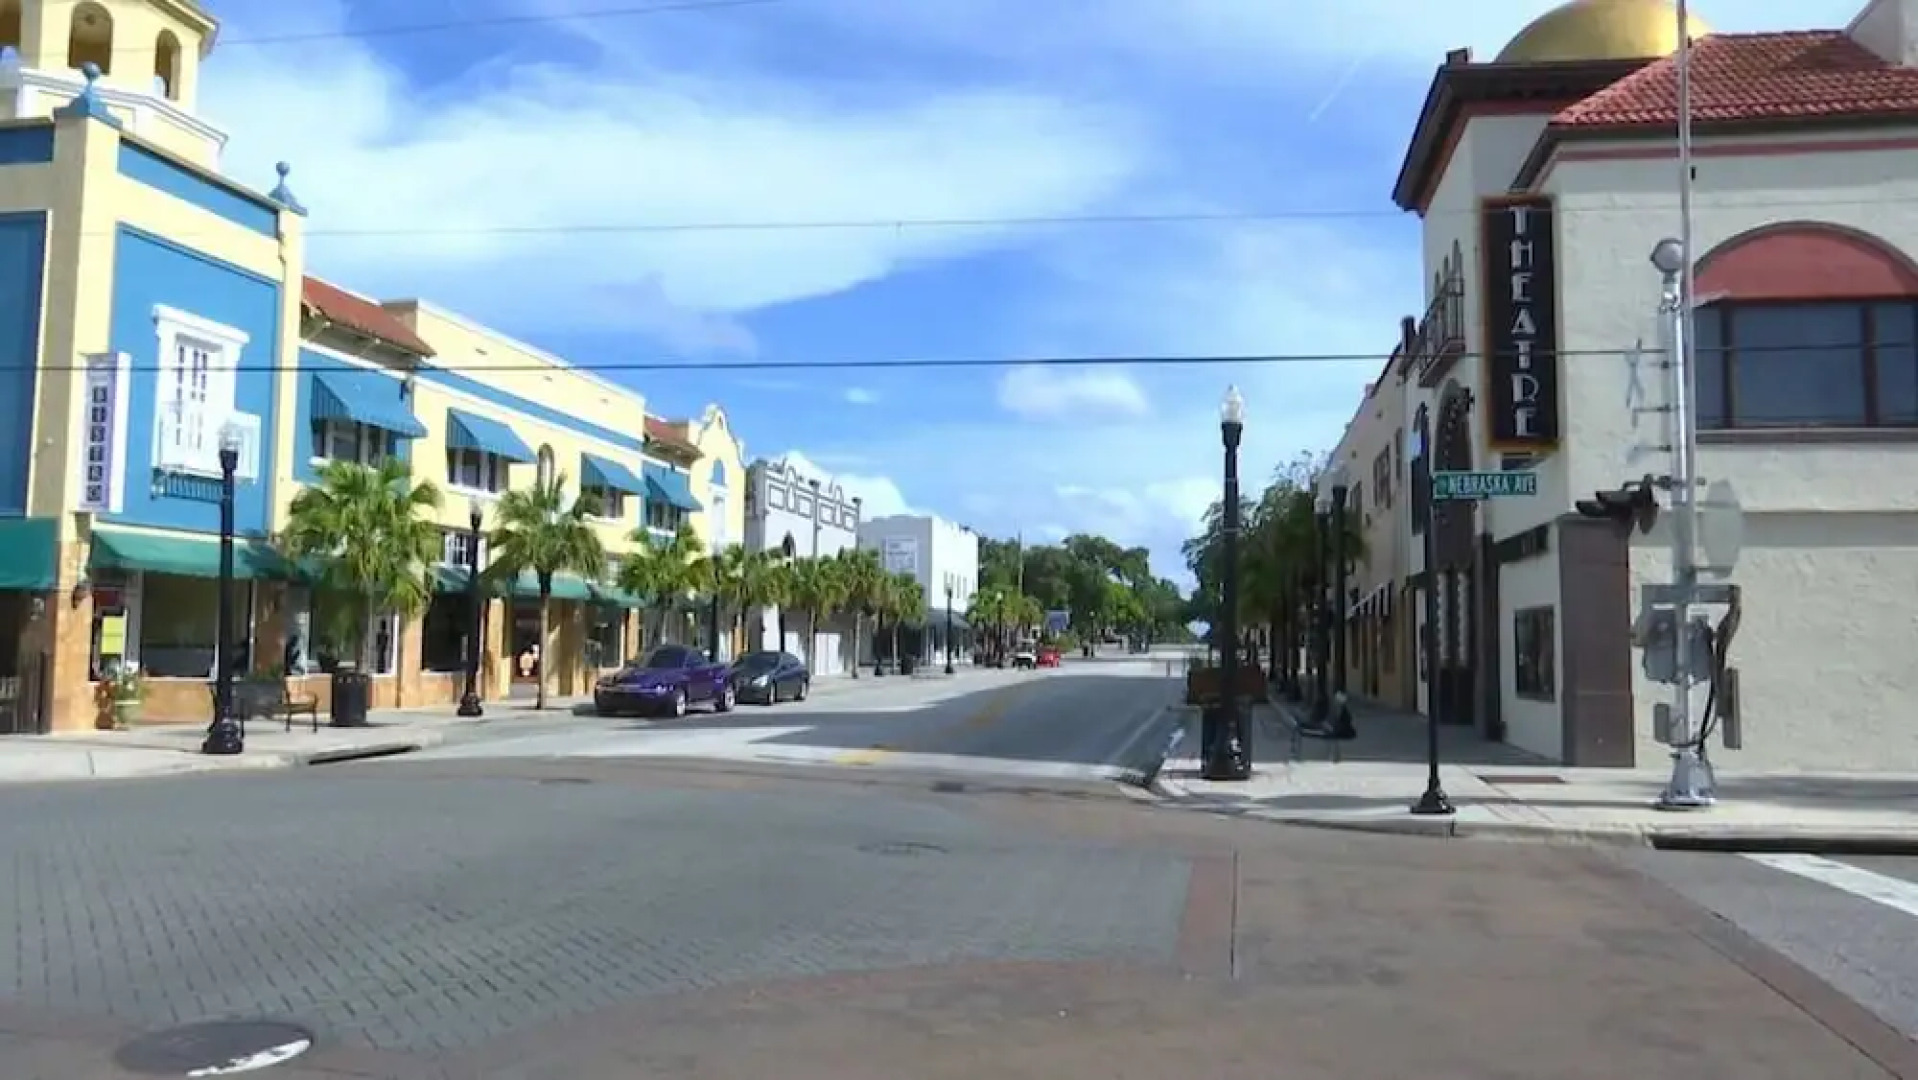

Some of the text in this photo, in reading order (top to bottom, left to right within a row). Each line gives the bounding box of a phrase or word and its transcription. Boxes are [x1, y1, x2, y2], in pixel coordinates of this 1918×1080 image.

[1510, 206, 1539, 437] THEATRE
[1448, 475, 1510, 493] NEBRASKA
[1514, 475, 1535, 492] AVE
